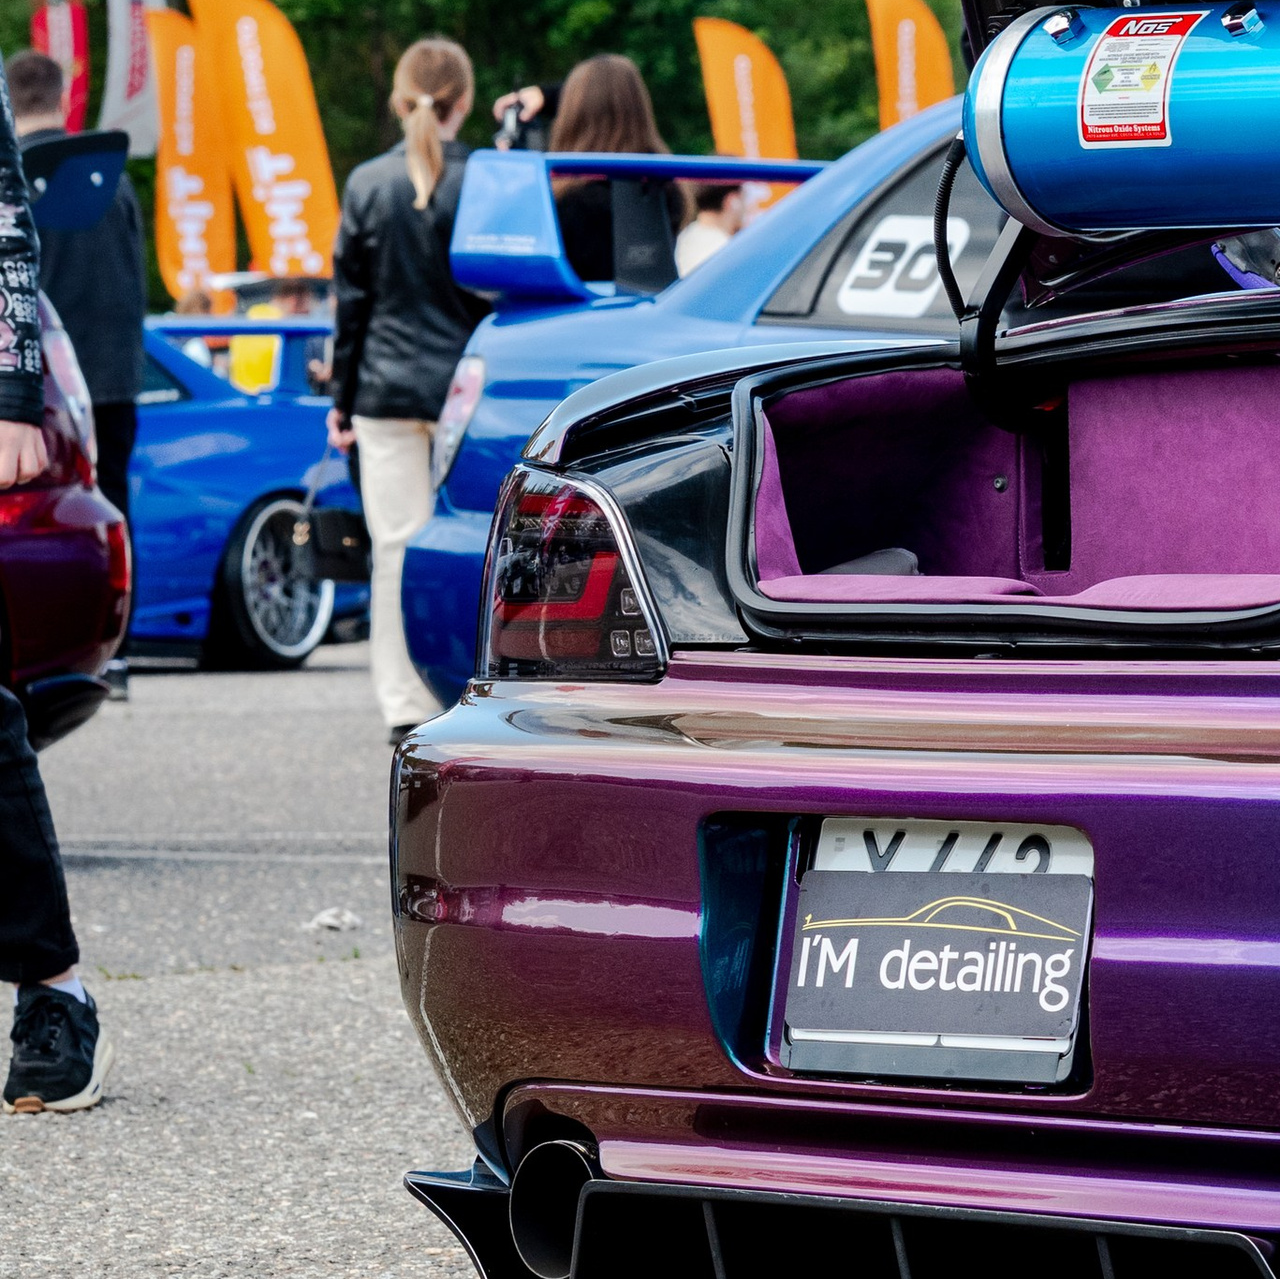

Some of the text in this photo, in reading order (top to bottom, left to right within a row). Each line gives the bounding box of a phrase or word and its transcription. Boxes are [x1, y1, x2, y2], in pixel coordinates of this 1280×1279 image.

[1118, 17, 1184, 35] NOS
[1088, 125, 1113, 134] Nitrous
[1134, 124, 1160, 134] Systems
[797, 935, 1074, 1012] I'M detailing
